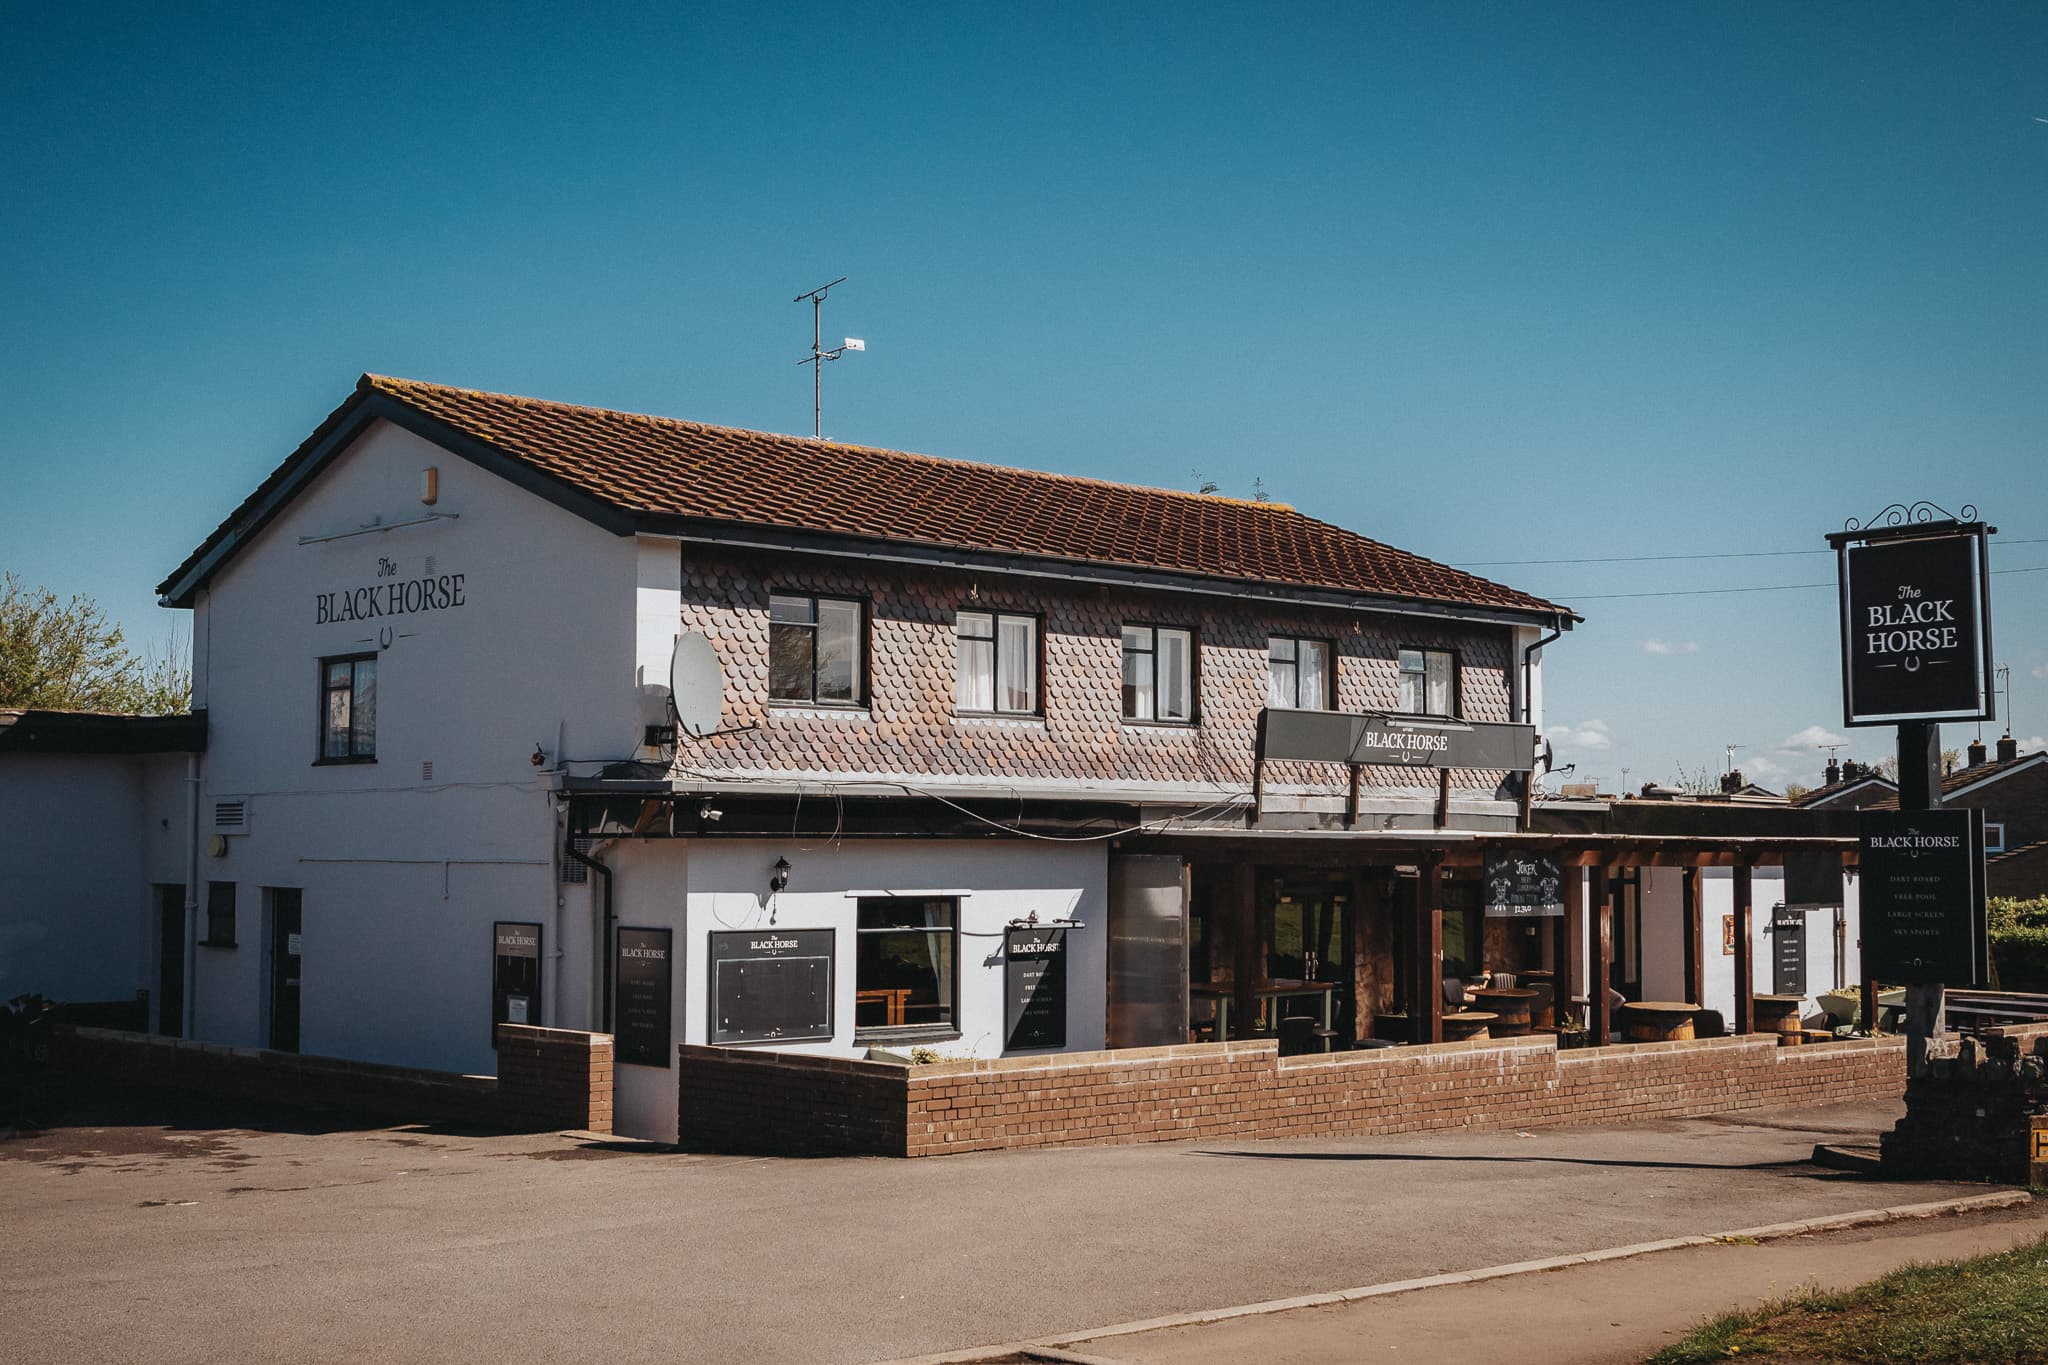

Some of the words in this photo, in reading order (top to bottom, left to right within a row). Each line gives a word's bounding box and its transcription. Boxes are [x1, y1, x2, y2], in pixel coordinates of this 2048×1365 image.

[378, 557, 398, 578] The
[316, 586, 383, 624] BLACK
[387, 574, 466, 616] HORSE
[1898, 585, 1922, 599] The
[1867, 600, 1955, 627] BLACK
[1866, 627, 1958, 654] HORSE
[1366, 731, 1407, 749] BLACK
[1407, 734, 1448, 751] HORSE
[1870, 836, 1912, 848] BLACK
[1914, 836, 1960, 848] HORSE
[498, 935, 517, 945] BLACK
[517, 936, 537, 946] HORSE
[751, 941, 773, 949] BLACK
[774, 940, 798, 949] HORSE
[622, 948, 642, 958] BLACK
[643, 949, 665, 959] HORSE
[1013, 944, 1036, 953] BLACK
